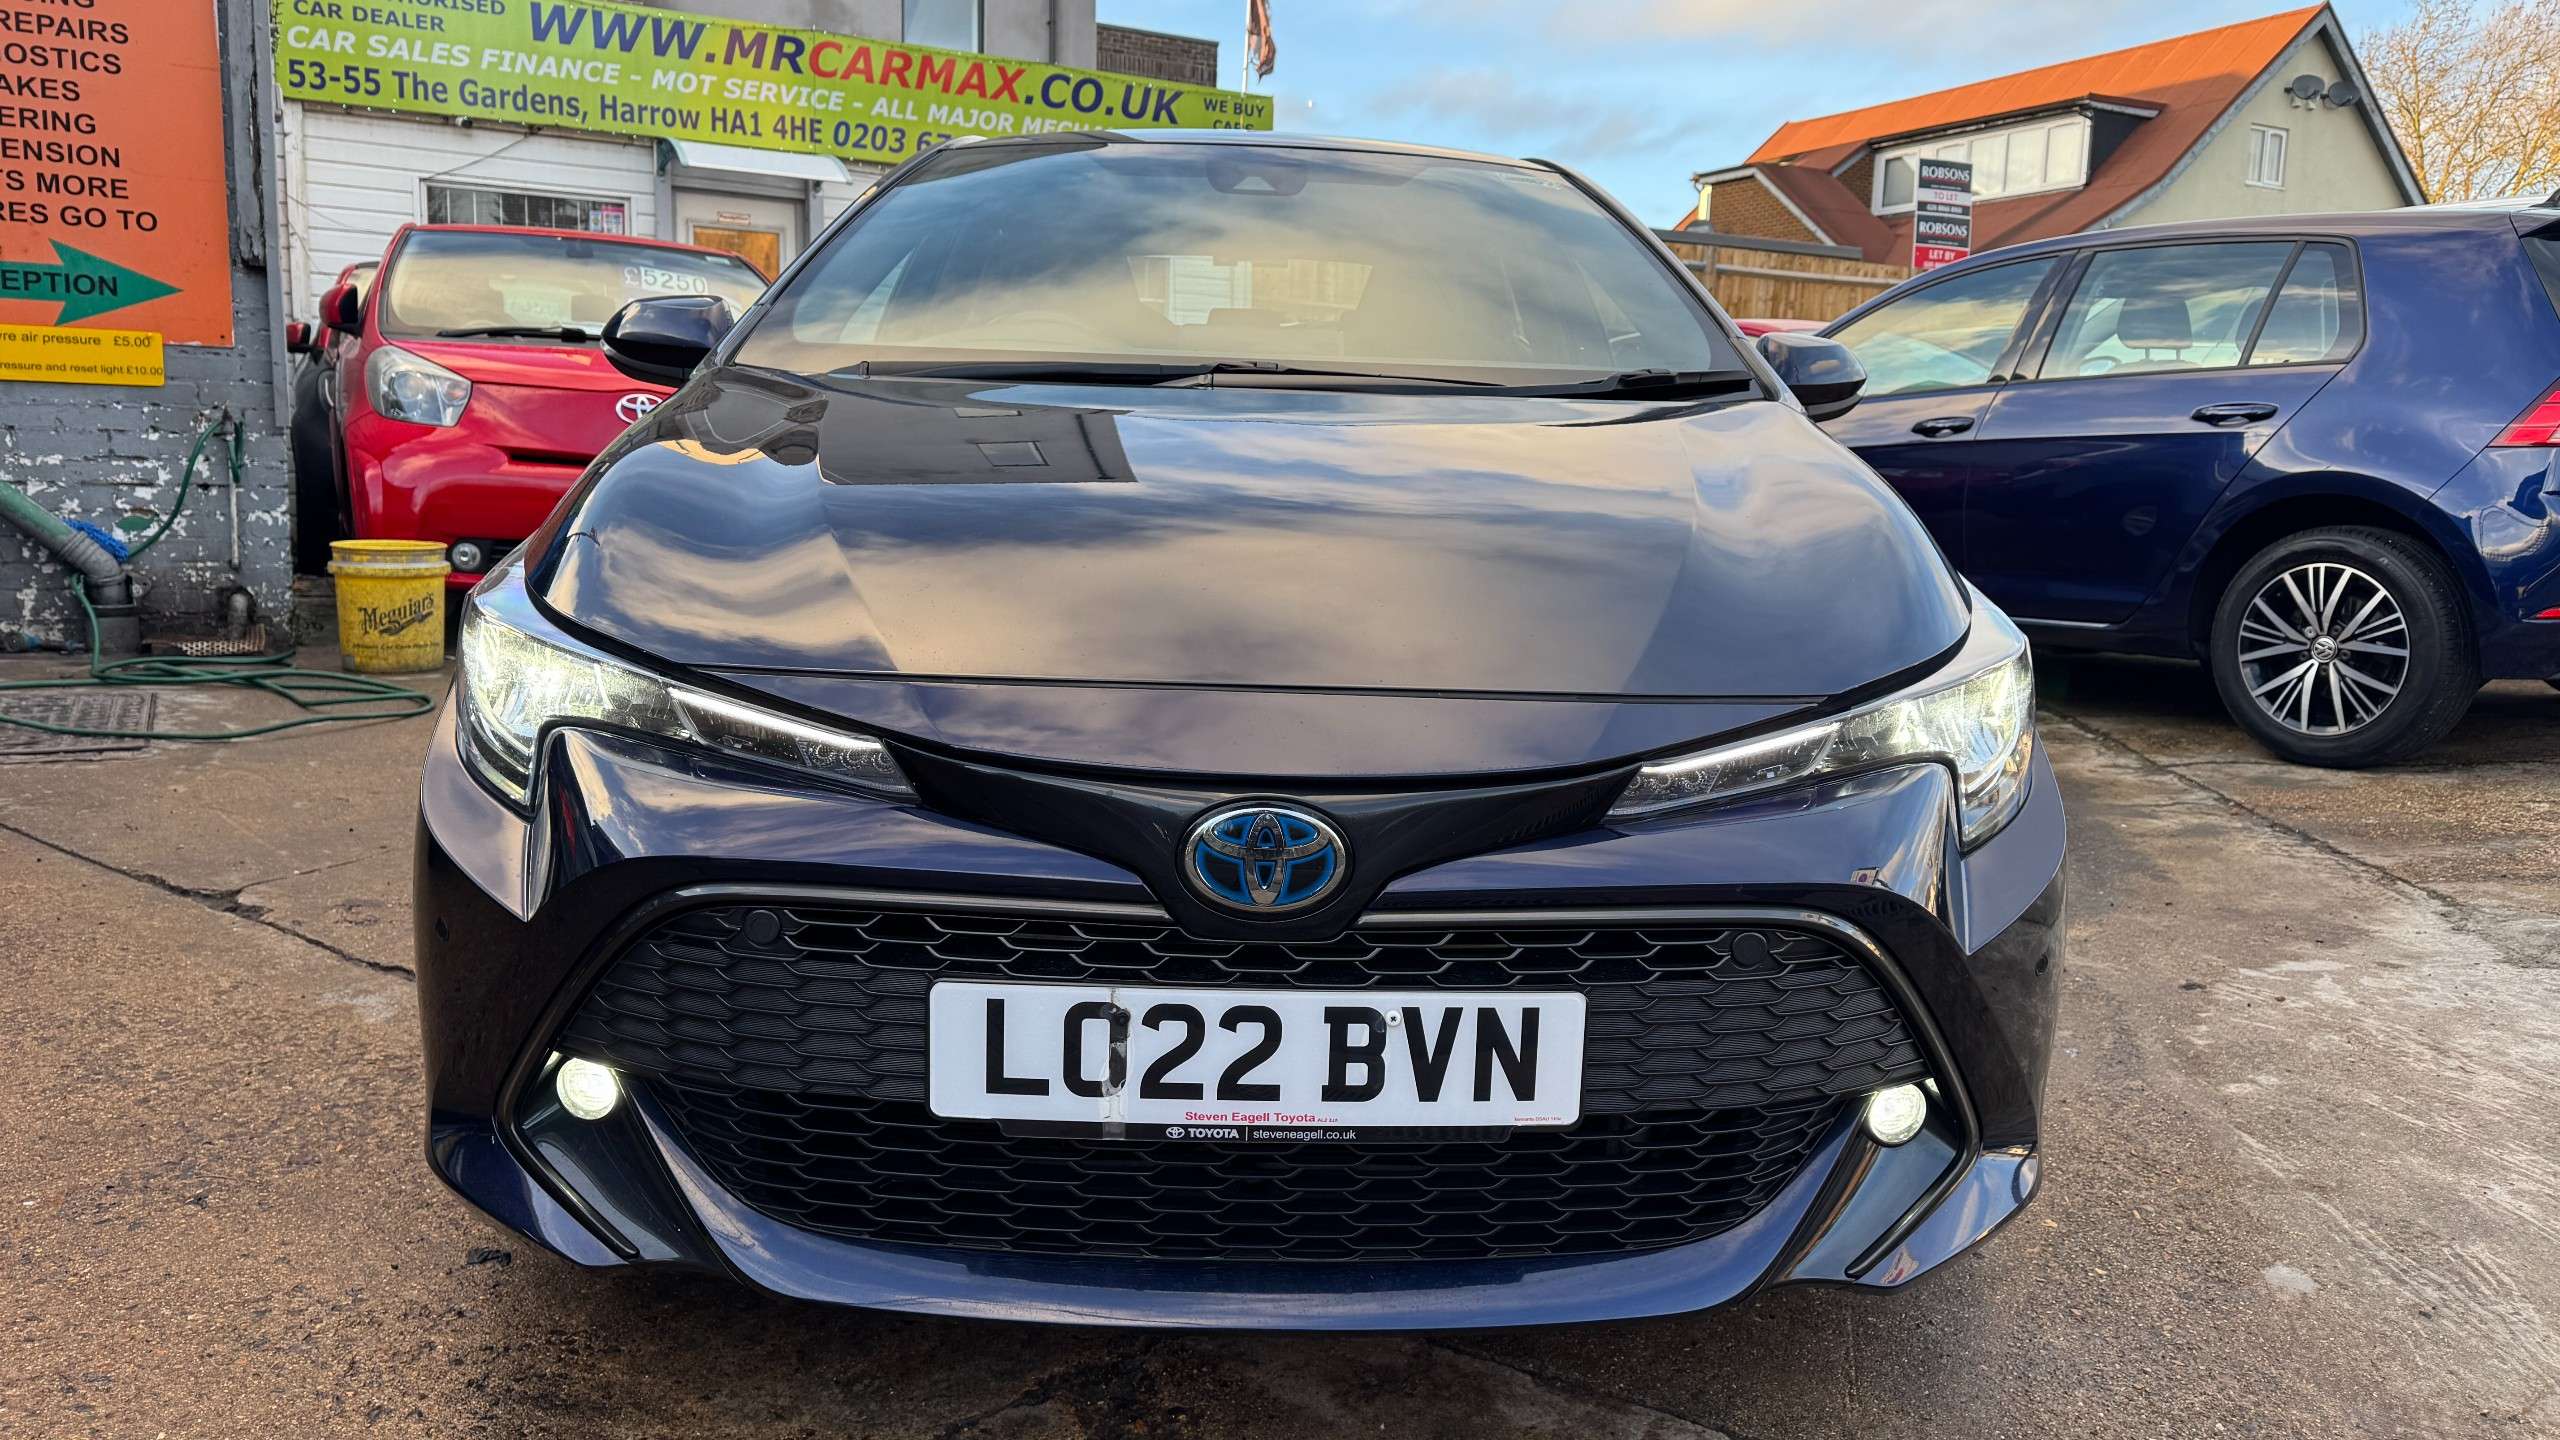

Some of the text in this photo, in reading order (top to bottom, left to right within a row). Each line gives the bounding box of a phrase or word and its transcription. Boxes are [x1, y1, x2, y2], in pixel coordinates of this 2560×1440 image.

[0, 10, 129, 44] REPAIRS
[293, 0, 445, 32] CAR DEALER
[529, 1, 1184, 125] WWW.MRCARMAX.CO.UK
[0, 74, 80, 102] AKES
[287, 26, 357, 54] CAR
[366, 34, 471, 67] SALES
[481, 48, 622, 85] FINANCE
[652, 68, 717, 96] MOT
[723, 78, 845, 112] SERVICE
[871, 96, 918, 121] ALL
[927, 104, 1015, 133] MAJOR
[288, 59, 381, 97] 53-55
[392, 70, 448, 103] The
[459, 78, 588, 124] Gardens,
[600, 94, 700, 130] Harrow
[711, 106, 763, 137] HA1
[773, 115, 823, 144] 4HE
[833, 120, 906, 153] 0203
[1203, 98, 1264, 118] WE BUY
[1, 138, 120, 168] ENSION
[36, 172, 129, 199] MORE
[1921, 165, 1970, 181] ROBSONS
[60, 206, 107, 228] GO
[116, 209, 158, 232] TO
[1919, 221, 1968, 237] ROBSONS
[1, 269, 118, 297] EPTION
[21, 331, 39, 342] air
[42, 333, 102, 347] pressure
[113, 336, 152, 349] £5.00
[45, 363, 67, 374] and
[70, 364, 98, 375] reset
[101, 364, 126, 376] light
[127, 366, 163, 378] £10.00
[985, 998, 1542, 1103] LO22 BVN
[1185, 1111, 1228, 1122] Steven
[1231, 1112, 1270, 1124] Eagell
[1273, 1112, 1316, 1125] Toyota
[1188, 1128, 1357, 1140] TOYOTA steveneagell.co.uk
